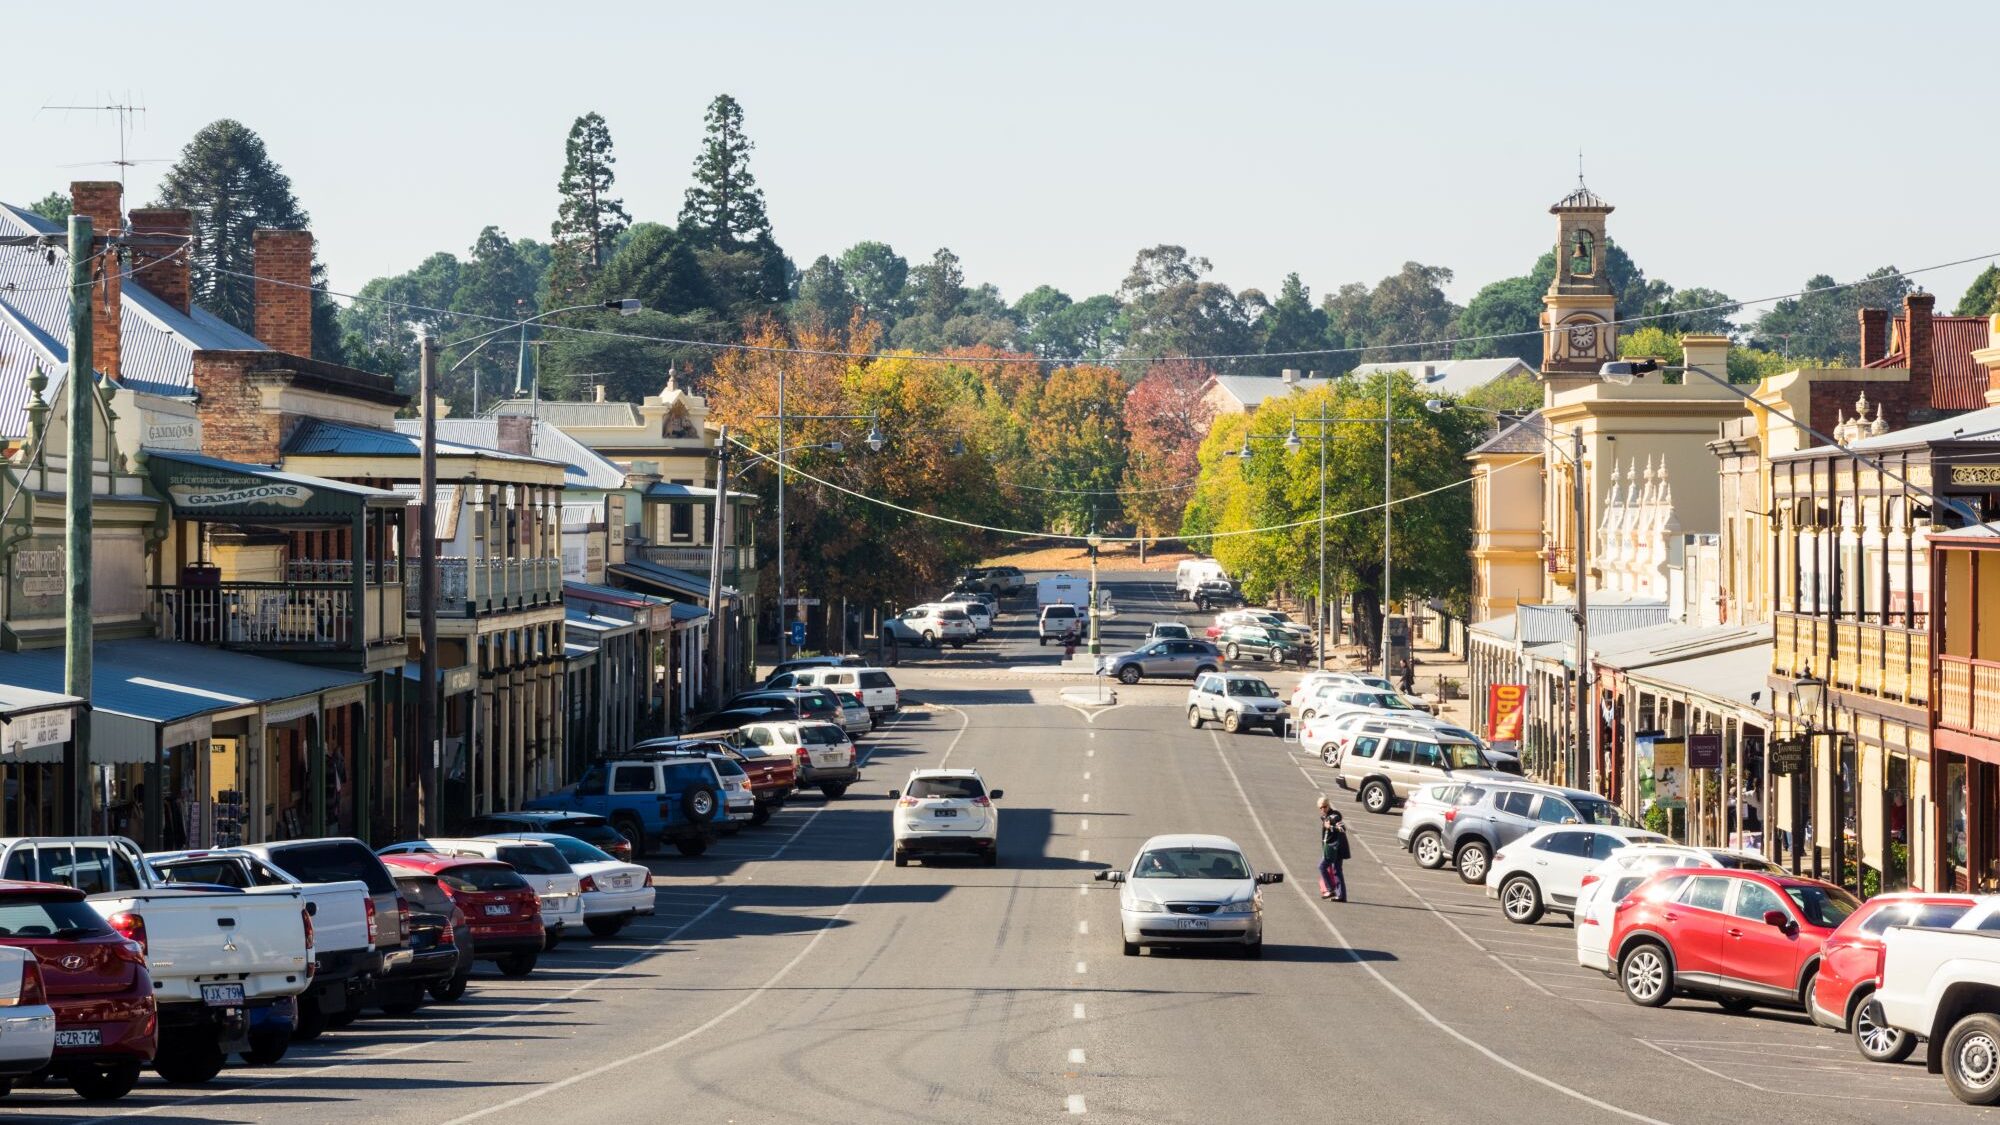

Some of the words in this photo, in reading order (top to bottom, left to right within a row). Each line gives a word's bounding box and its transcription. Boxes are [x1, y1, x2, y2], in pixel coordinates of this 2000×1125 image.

[149, 424, 194, 440] GAMMONS
[189, 486, 298, 505] GAMMONS
[1495, 686, 1521, 740] OPEN
